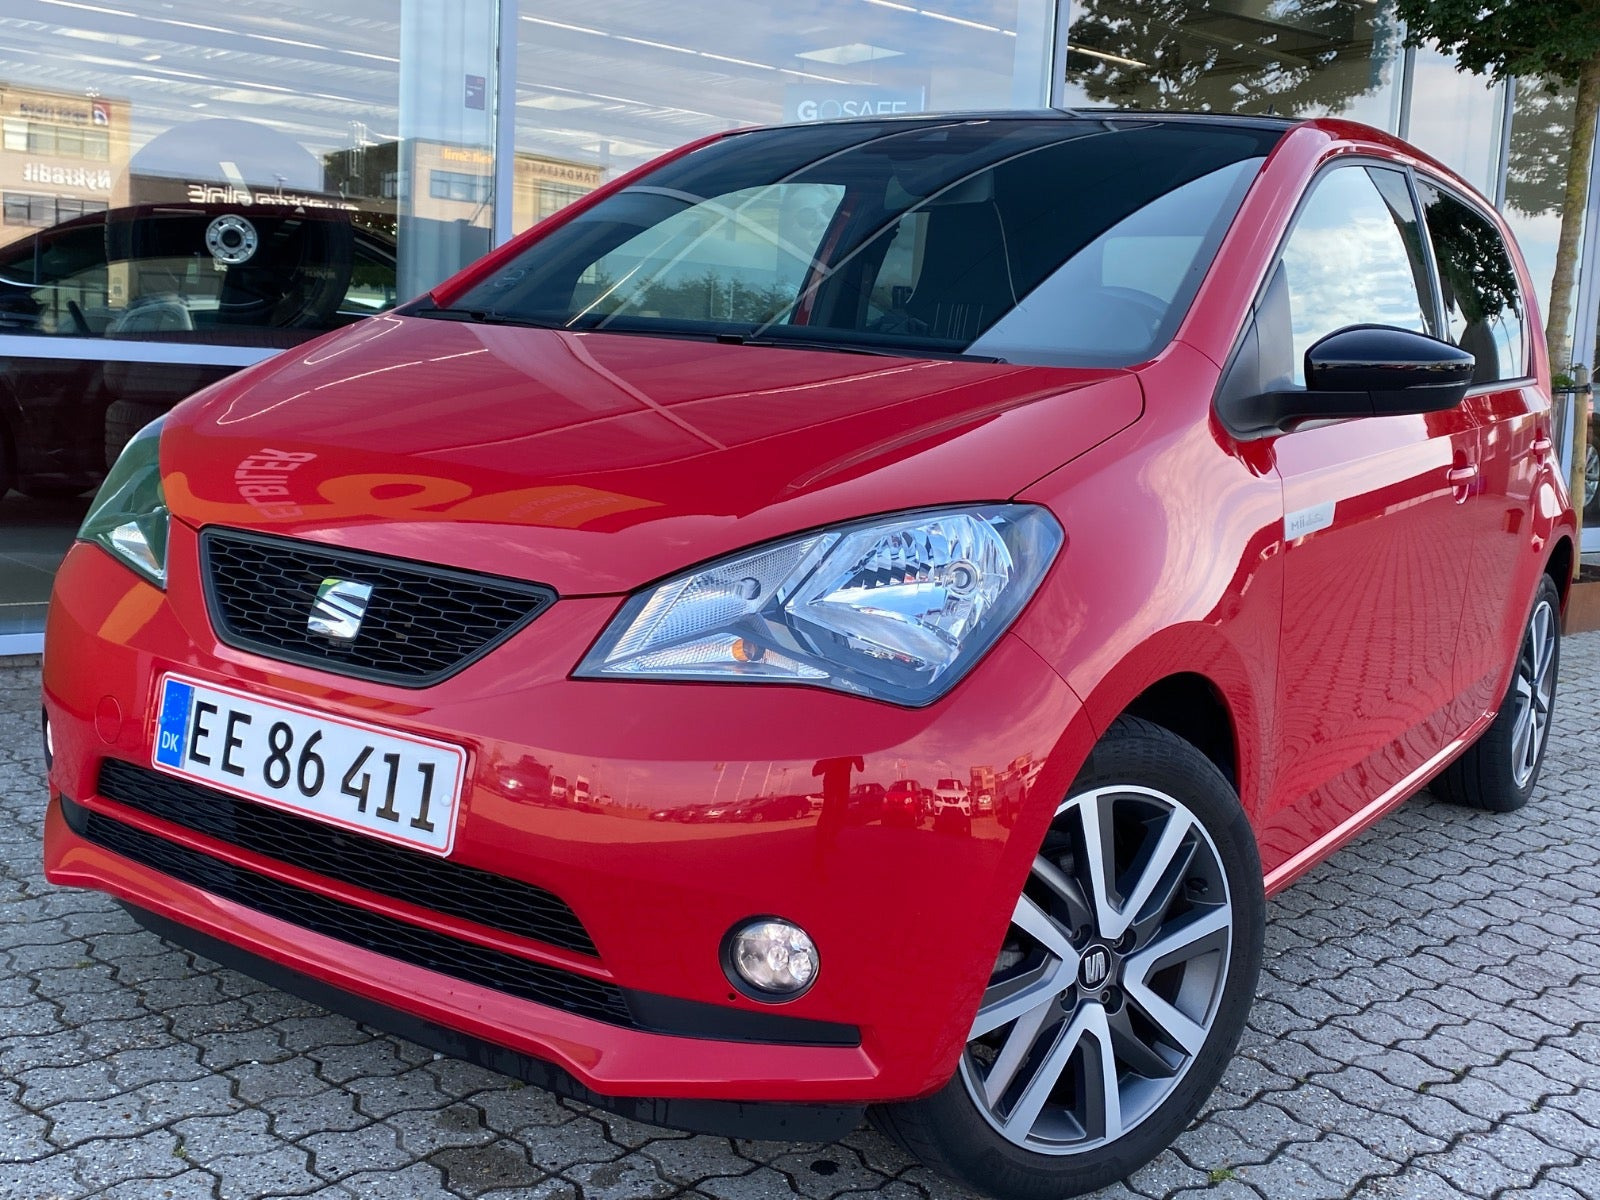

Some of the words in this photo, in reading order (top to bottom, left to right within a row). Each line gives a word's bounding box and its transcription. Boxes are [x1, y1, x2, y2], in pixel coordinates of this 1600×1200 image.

[161, 730, 180, 753] DK
[189, 700, 252, 777] EE
[263, 721, 325, 798] 86
[340, 745, 436, 833] 411
